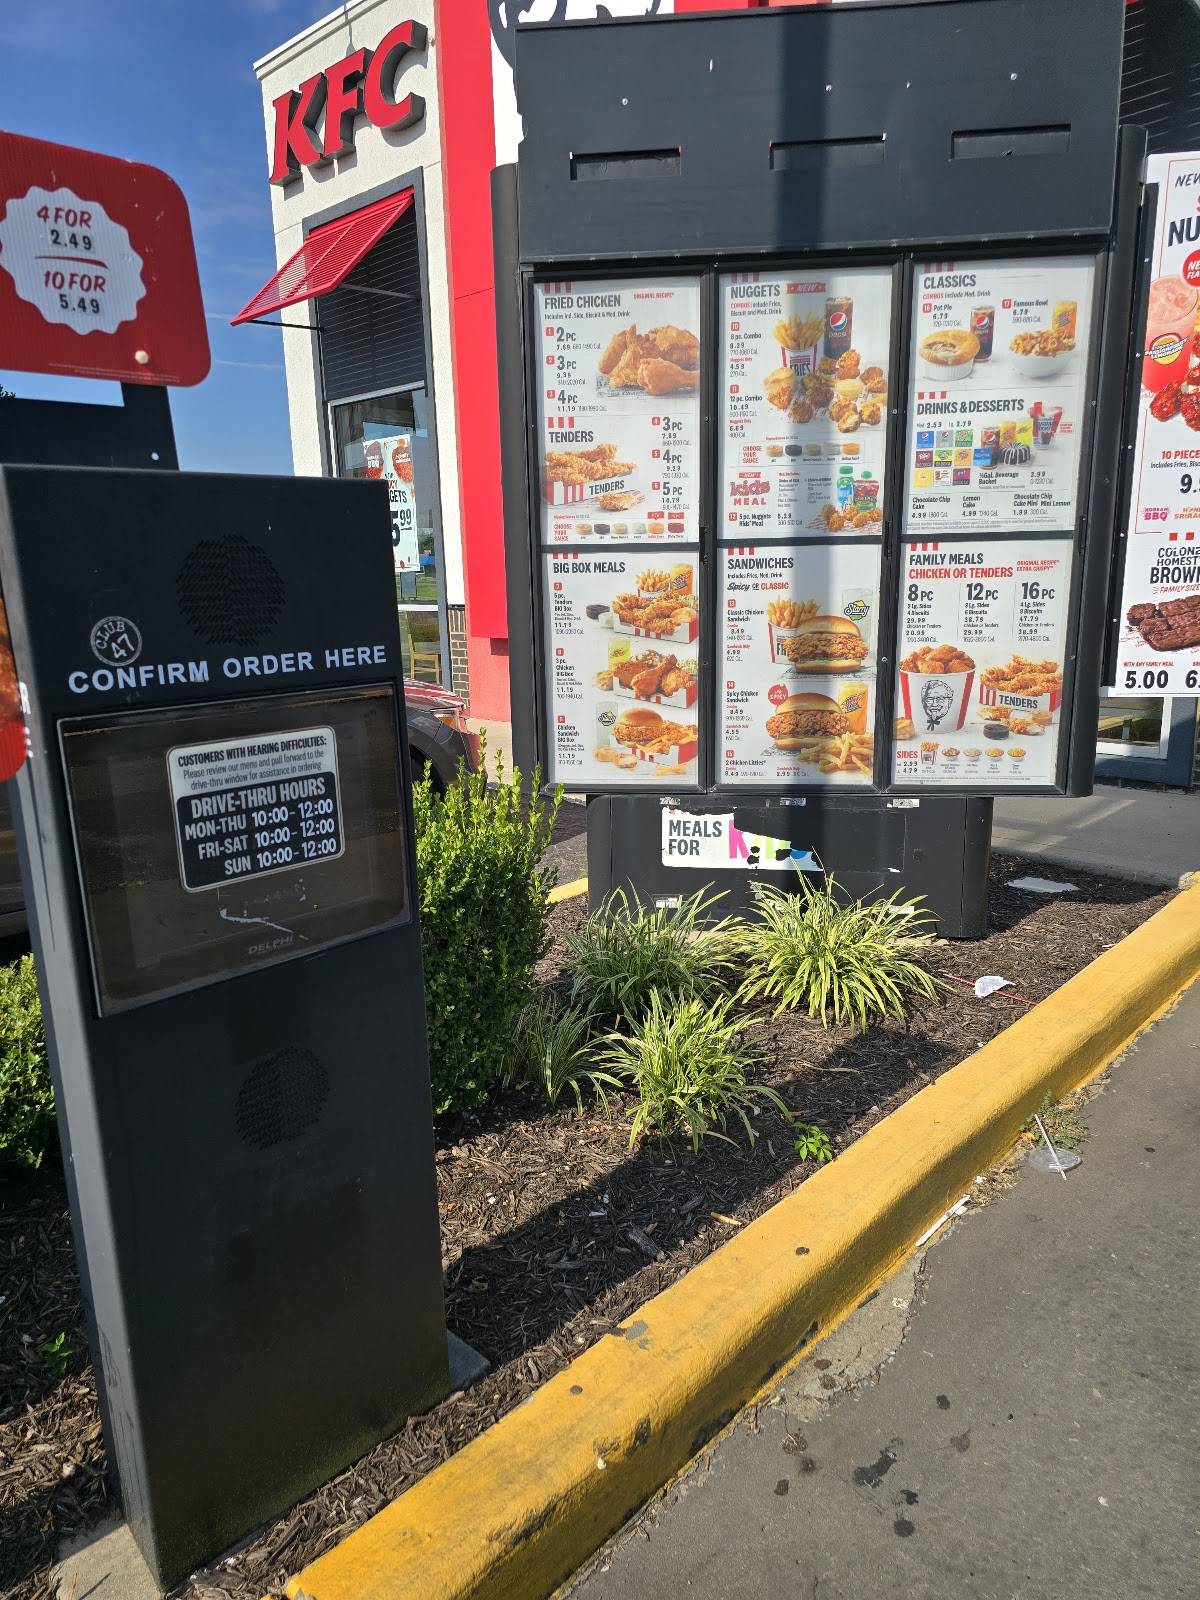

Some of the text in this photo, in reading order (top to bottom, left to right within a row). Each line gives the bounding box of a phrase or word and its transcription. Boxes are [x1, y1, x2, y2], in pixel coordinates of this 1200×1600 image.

[270, 19, 428, 186] KFC
[37, 206, 92, 229] 4 FOR
[51, 229, 92, 250] 2.49
[1168, 216, 1200, 247] NU
[44, 271, 106, 292] 10 FOR
[924, 275, 976, 289] CLASSICS
[731, 285, 780, 299] NUGGETS
[59, 294, 100, 314] 5.49
[544, 295, 621, 309] FRIED CHICKEN
[917, 399, 1024, 415] DRINKS & DESSERTS
[549, 431, 594, 443] TENDERS
[1162, 451, 1171, 459] 10
[589, 480, 624, 495] TENDERS
[1180, 474, 1200, 493] 9.
[734, 498, 766, 506] MEAL
[400, 509, 412, 527] 99
[1143, 512, 1168, 520] BBQ
[553, 562, 625, 573] BIG BOX MEALS
[728, 557, 794, 569] SANDWICHES
[909, 553, 983, 566] FAMILY MEALS
[909, 566, 1013, 580] CHICKEN OR TENDERS
[727, 582, 789, 591] Spicy CLASSIC
[1160, 585, 1185, 593] FAMILY
[95, 621, 126, 650] CLUB
[110, 632, 136, 659] 47
[68, 645, 387, 694] CONFIRM ORDER HERE
[1125, 670, 1169, 689] 5.00
[999, 694, 1038, 709] TENDERS
[178, 736, 327, 767] CUSTOMERS WITH HEARING DIFFICULTIES:
[897, 750, 918, 759] SIDES
[183, 750, 324, 779] Please review our menu and pull forward to the
[191, 778, 224, 791] drive-thru
[225, 774, 248, 784] window
[249, 771, 258, 780] for
[259, 767, 290, 779] assistance
[298, 761, 322, 774] ordering
[191, 777, 326, 819] DRIVE-THRU HOURS
[185, 815, 247, 841] MON-THU
[298, 799, 333, 819] 12:00
[668, 820, 722, 838] MEALS
[198, 835, 248, 860] FRI-SAT
[300, 818, 335, 838] 12:00
[668, 839, 700, 856] FOR
[224, 856, 251, 875] SUN
[301, 838, 336, 858] 12:00
